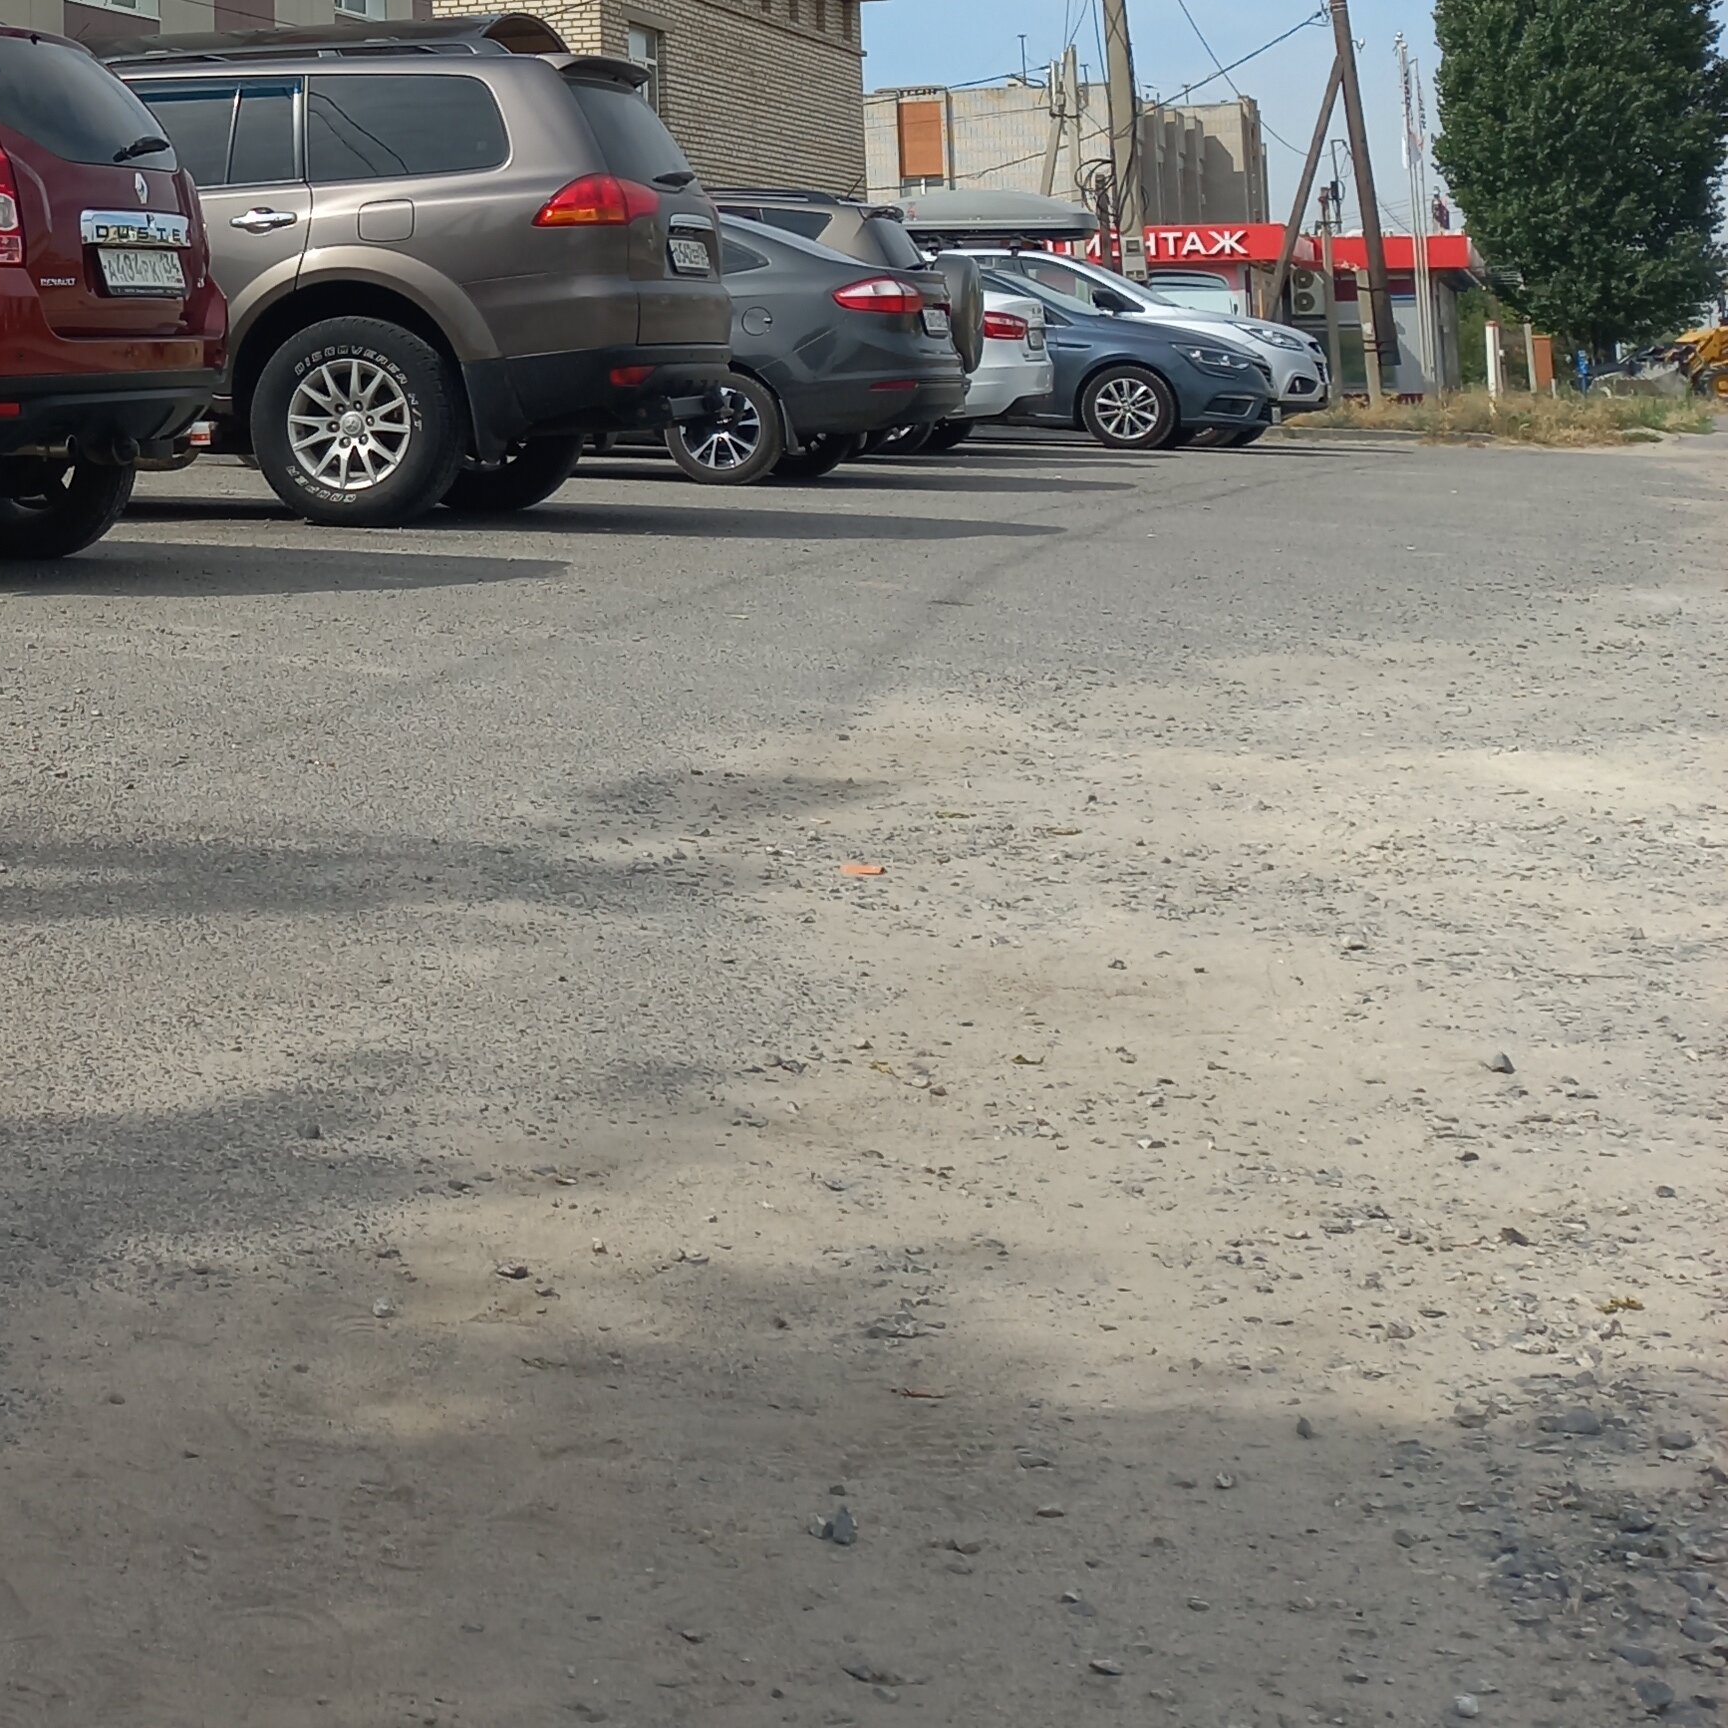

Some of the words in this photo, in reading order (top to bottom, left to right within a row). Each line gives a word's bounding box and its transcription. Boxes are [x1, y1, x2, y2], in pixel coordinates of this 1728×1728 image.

[95, 224, 189, 244] DUSTE
[293, 344, 409, 386] DISCOVERER
[285, 465, 358, 504] COOPER
